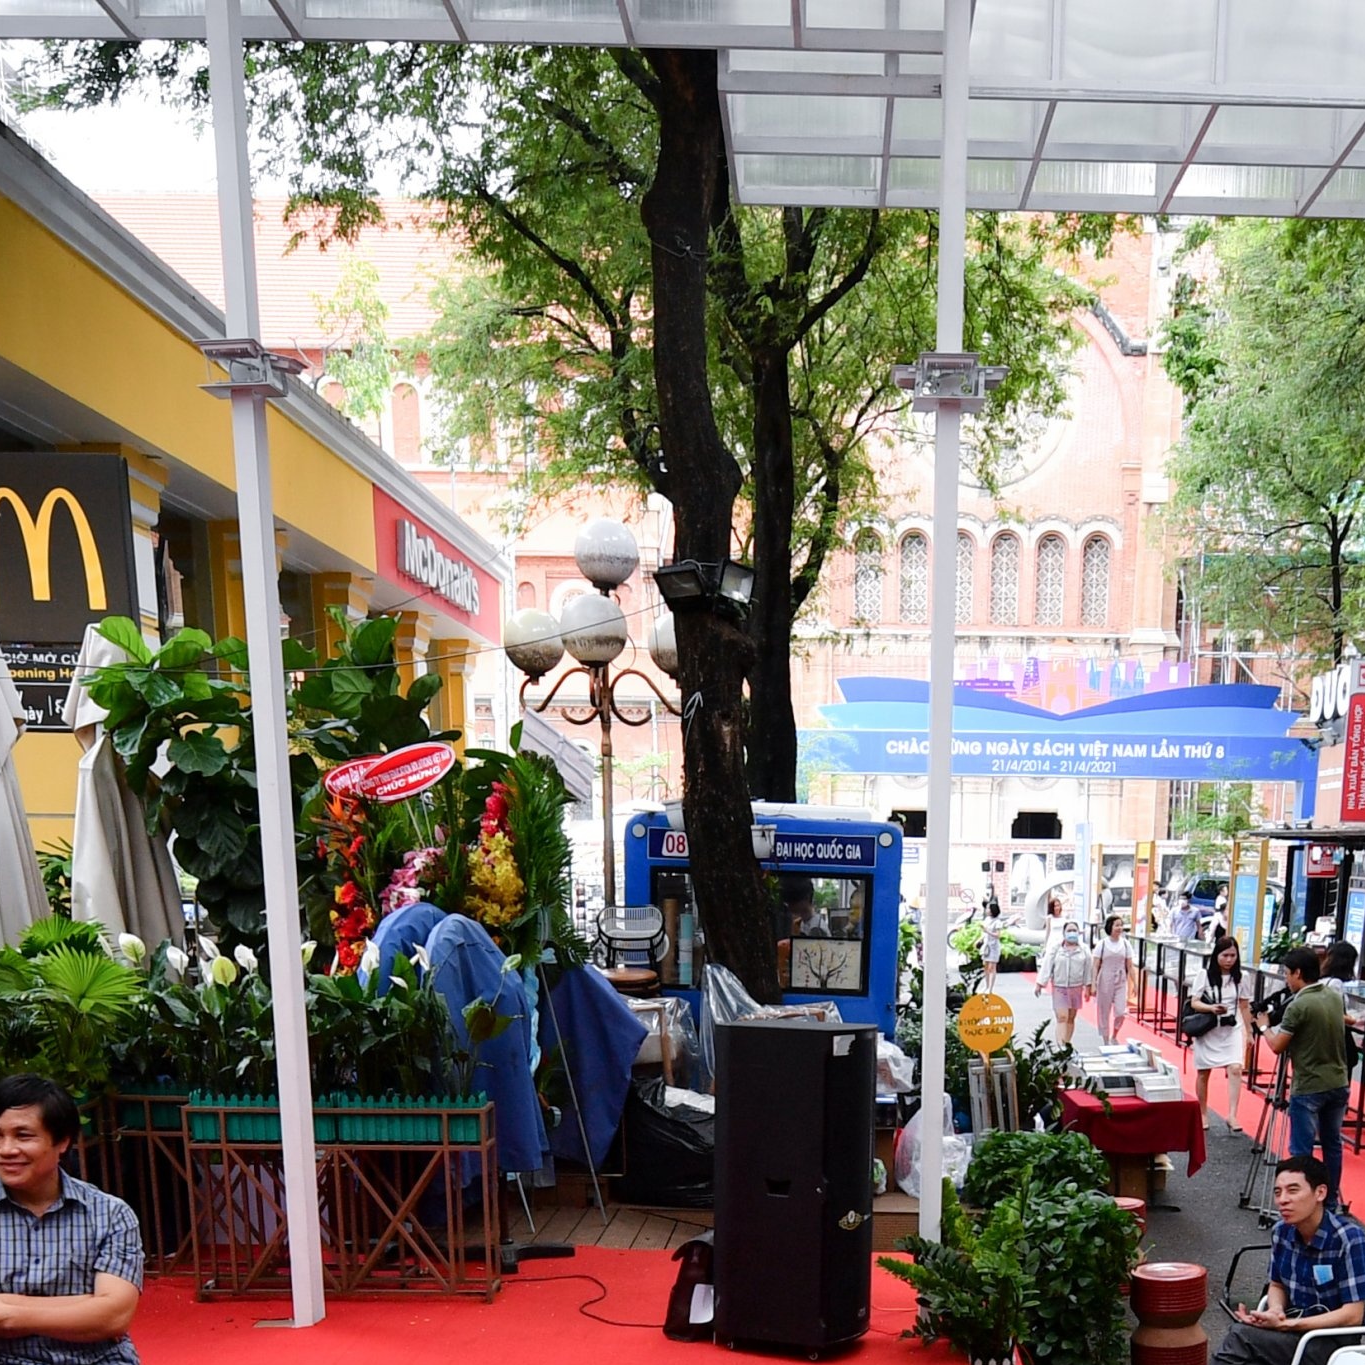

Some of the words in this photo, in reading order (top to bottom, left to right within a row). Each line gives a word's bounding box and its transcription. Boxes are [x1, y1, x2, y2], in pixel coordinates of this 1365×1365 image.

[32, 651, 57, 664] MỞ
[9, 667, 56, 681] pening
[886, 736, 930, 755] CHÀO
[951, 737, 983, 756] ỪNG
[986, 738, 1029, 757] NGÀY
[1032, 738, 1075, 757] SÁCH
[1079, 739, 1109, 760] VIỆT
[1112, 743, 1147, 759] NAM
[1151, 738, 1180, 759] LẦN
[1183, 741, 1213, 759] THỨ
[1215, 745, 1225, 759] 8
[991, 758, 1050, 773] 21/4/2014
[1059, 759, 1117, 774] 21/4/2021
[376, 779, 407, 795] CHÚC
[408, 764, 441, 783] MỪNG
[665, 833, 686, 854] 08
[776, 843, 794, 860] ĐẠI
[795, 843, 815, 861] HỌC
[816, 838, 844, 860] QUỐC
[844, 844, 862, 860] GIA
